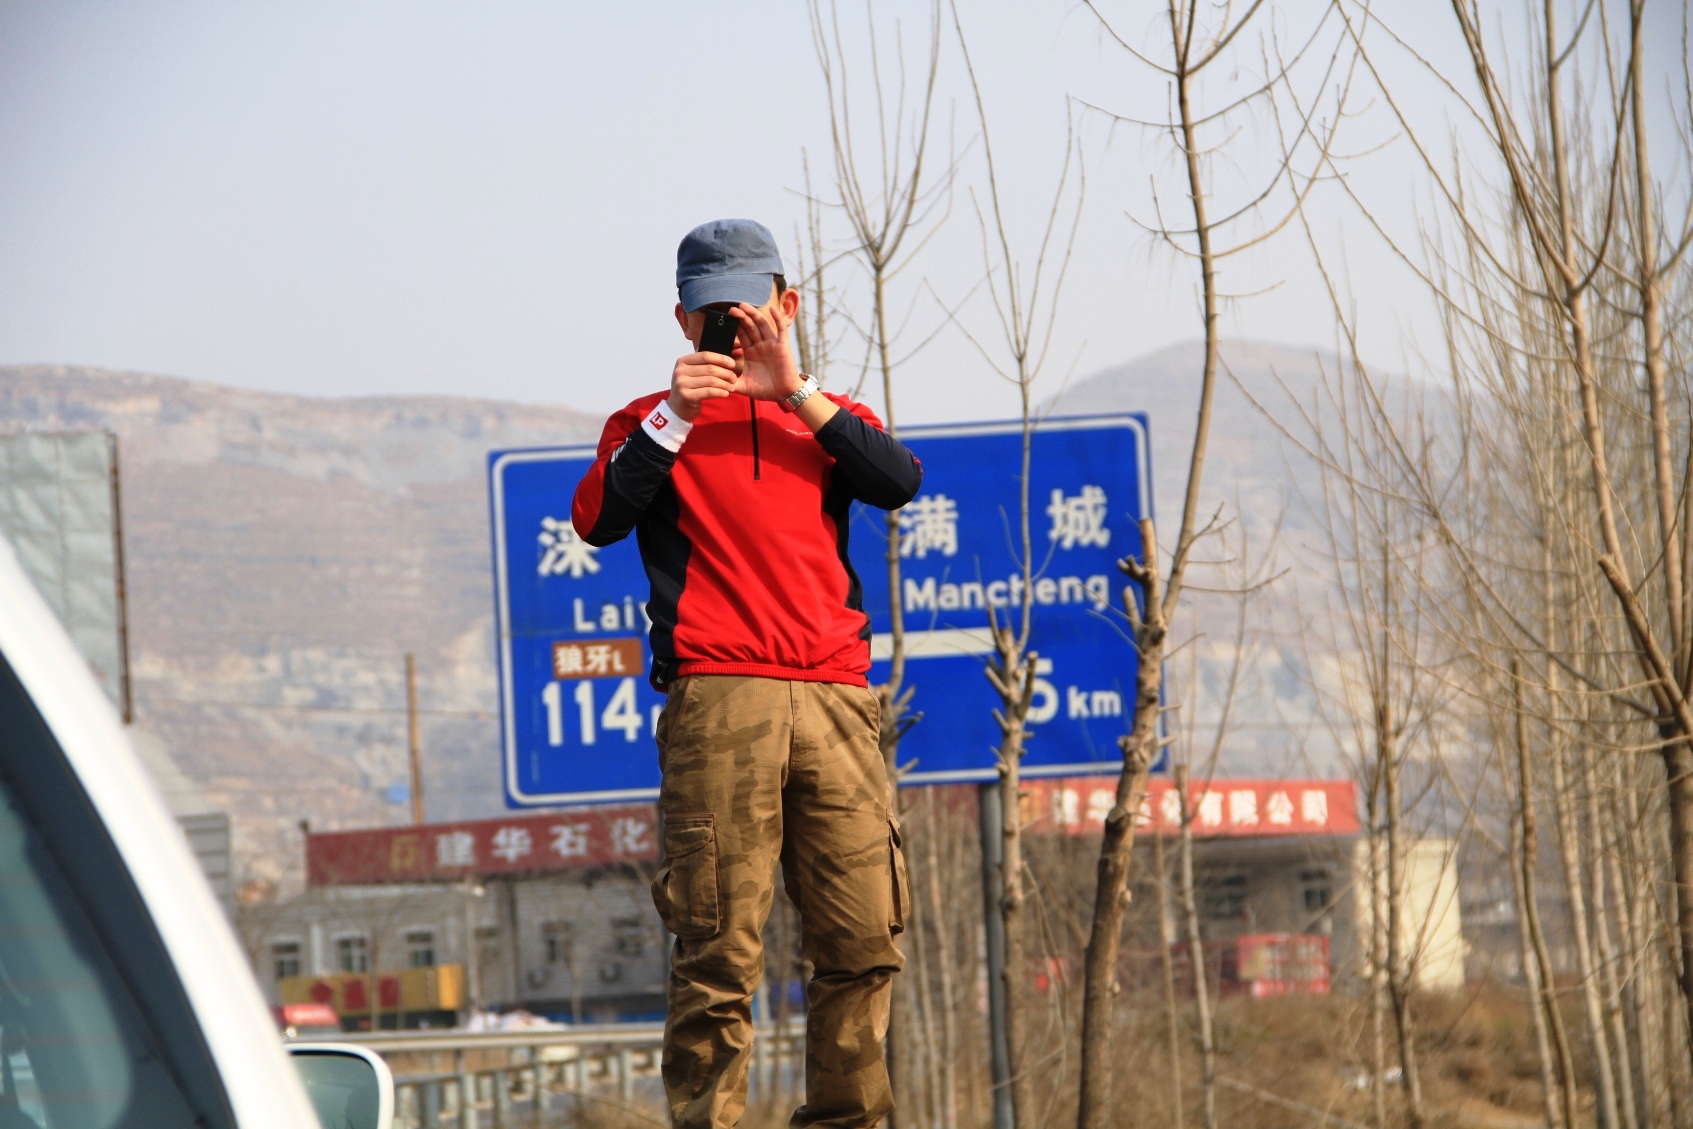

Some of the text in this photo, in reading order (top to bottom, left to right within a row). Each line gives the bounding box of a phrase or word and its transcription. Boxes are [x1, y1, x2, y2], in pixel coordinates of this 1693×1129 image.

[898, 485, 1111, 557] 满城
[903, 573, 1109, 611] Mancheng
[542, 677, 644, 746] 114
[1067, 685, 1122, 719] km
[436, 817, 650, 868] 建华石化
